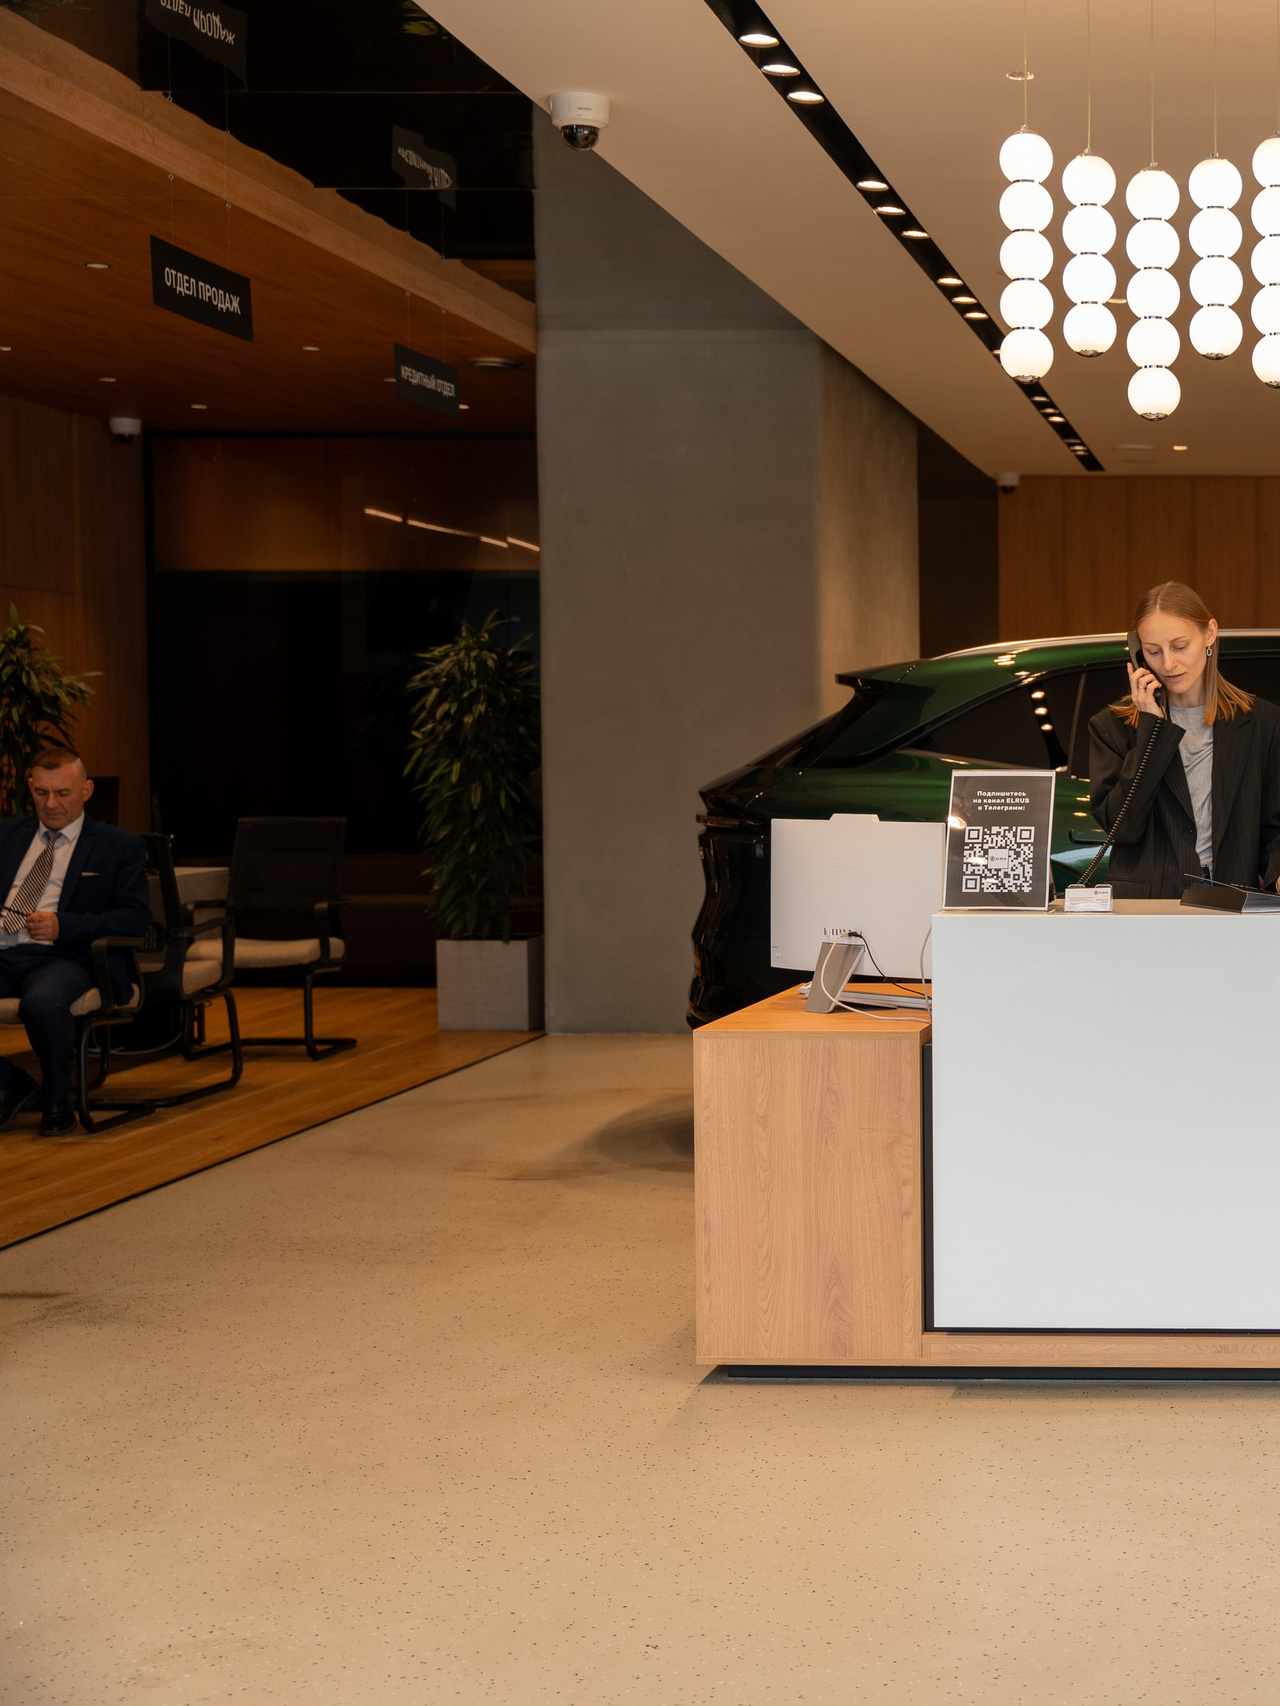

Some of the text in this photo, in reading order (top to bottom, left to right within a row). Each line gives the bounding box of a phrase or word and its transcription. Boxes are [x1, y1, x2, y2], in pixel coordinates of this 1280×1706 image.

[164, 267, 241, 315] ОТДЕЛ ПРОДАЖ
[400, 364, 456, 398] КРЕДИТНЫЙ ОТДЕЛ
[984, 804, 1026, 812] Телеграмм:
